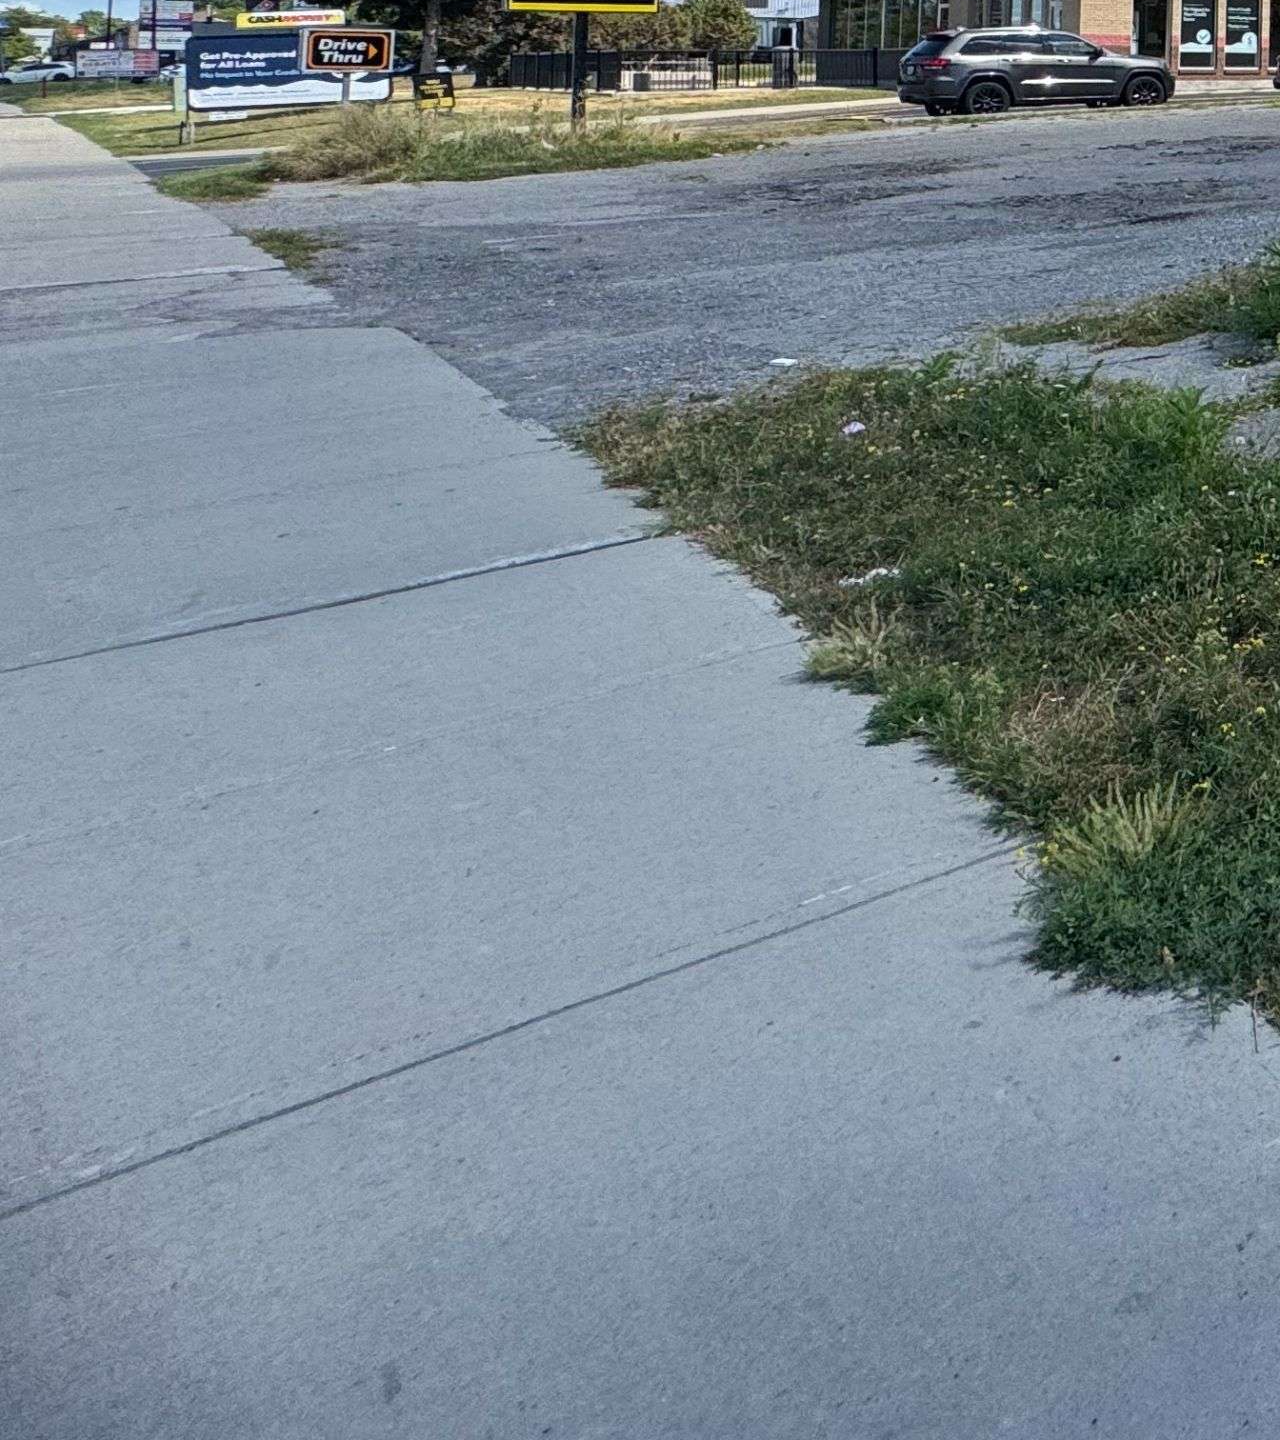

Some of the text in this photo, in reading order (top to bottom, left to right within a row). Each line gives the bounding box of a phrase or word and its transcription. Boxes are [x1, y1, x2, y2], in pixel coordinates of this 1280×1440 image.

[318, 38, 368, 52] Drive
[199, 52, 221, 60] Get
[320, 51, 364, 64] Thru
[199, 60, 266, 69] for All Loans
